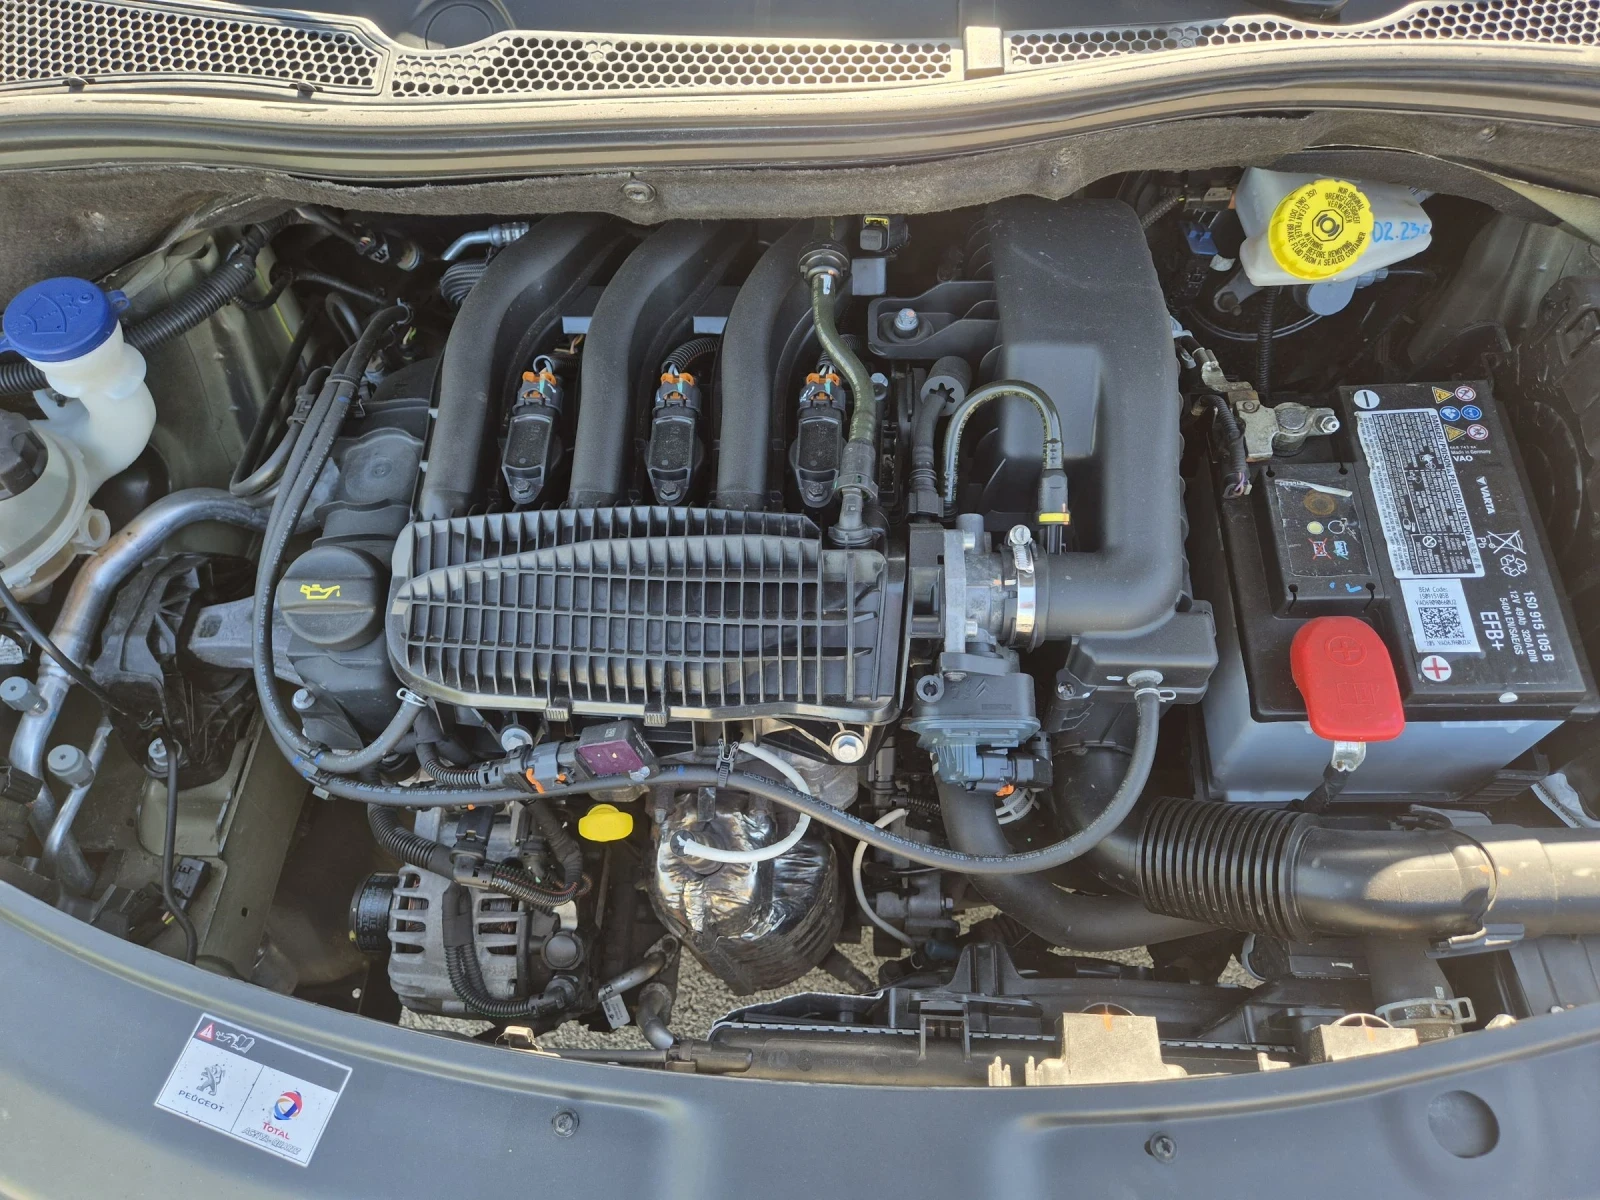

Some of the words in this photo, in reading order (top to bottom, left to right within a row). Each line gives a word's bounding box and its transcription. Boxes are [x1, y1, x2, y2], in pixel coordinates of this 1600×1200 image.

[1306, 189, 1316, 198] USE
[1338, 186, 1348, 194] NUR
[1348, 191, 1364, 210] ORIGINAL
[1296, 198, 1307, 210] ONLY
[1296, 203, 1310, 221] CLEAN
[1328, 200, 1353, 223] VERWENDEN
[1286, 224, 1295, 242] BRAKE
[1304, 232, 1323, 250] WARNING
[1291, 242, 1303, 256] FLUID
[1298, 238, 1308, 248] CAP
[1308, 246, 1326, 258] BEFORE
[1328, 241, 1352, 258] REMOVING
[1346, 232, 1366, 258] CONTAINER
[1302, 254, 1316, 265] FROM
[1324, 254, 1345, 266] SEALED
[1481, 485, 1496, 515] VARTA
[1477, 537, 1487, 549] Pb
[1499, 597, 1512, 615] 540A
[1510, 590, 1521, 604] 12V
[1515, 607, 1527, 625] 49Ah
[1529, 612, 1545, 630] 915
[1479, 612, 1504, 650] EFB+
[1505, 617, 1524, 655] EN/SAE/GS
[1521, 629, 1534, 648] 320A
[1536, 633, 1552, 651] 105
[1526, 650, 1538, 662] DIN
[1542, 654, 1555, 662] B
[178, 1090, 224, 1112] PEUGEOT
[262, 1122, 290, 1140] TOTAL
